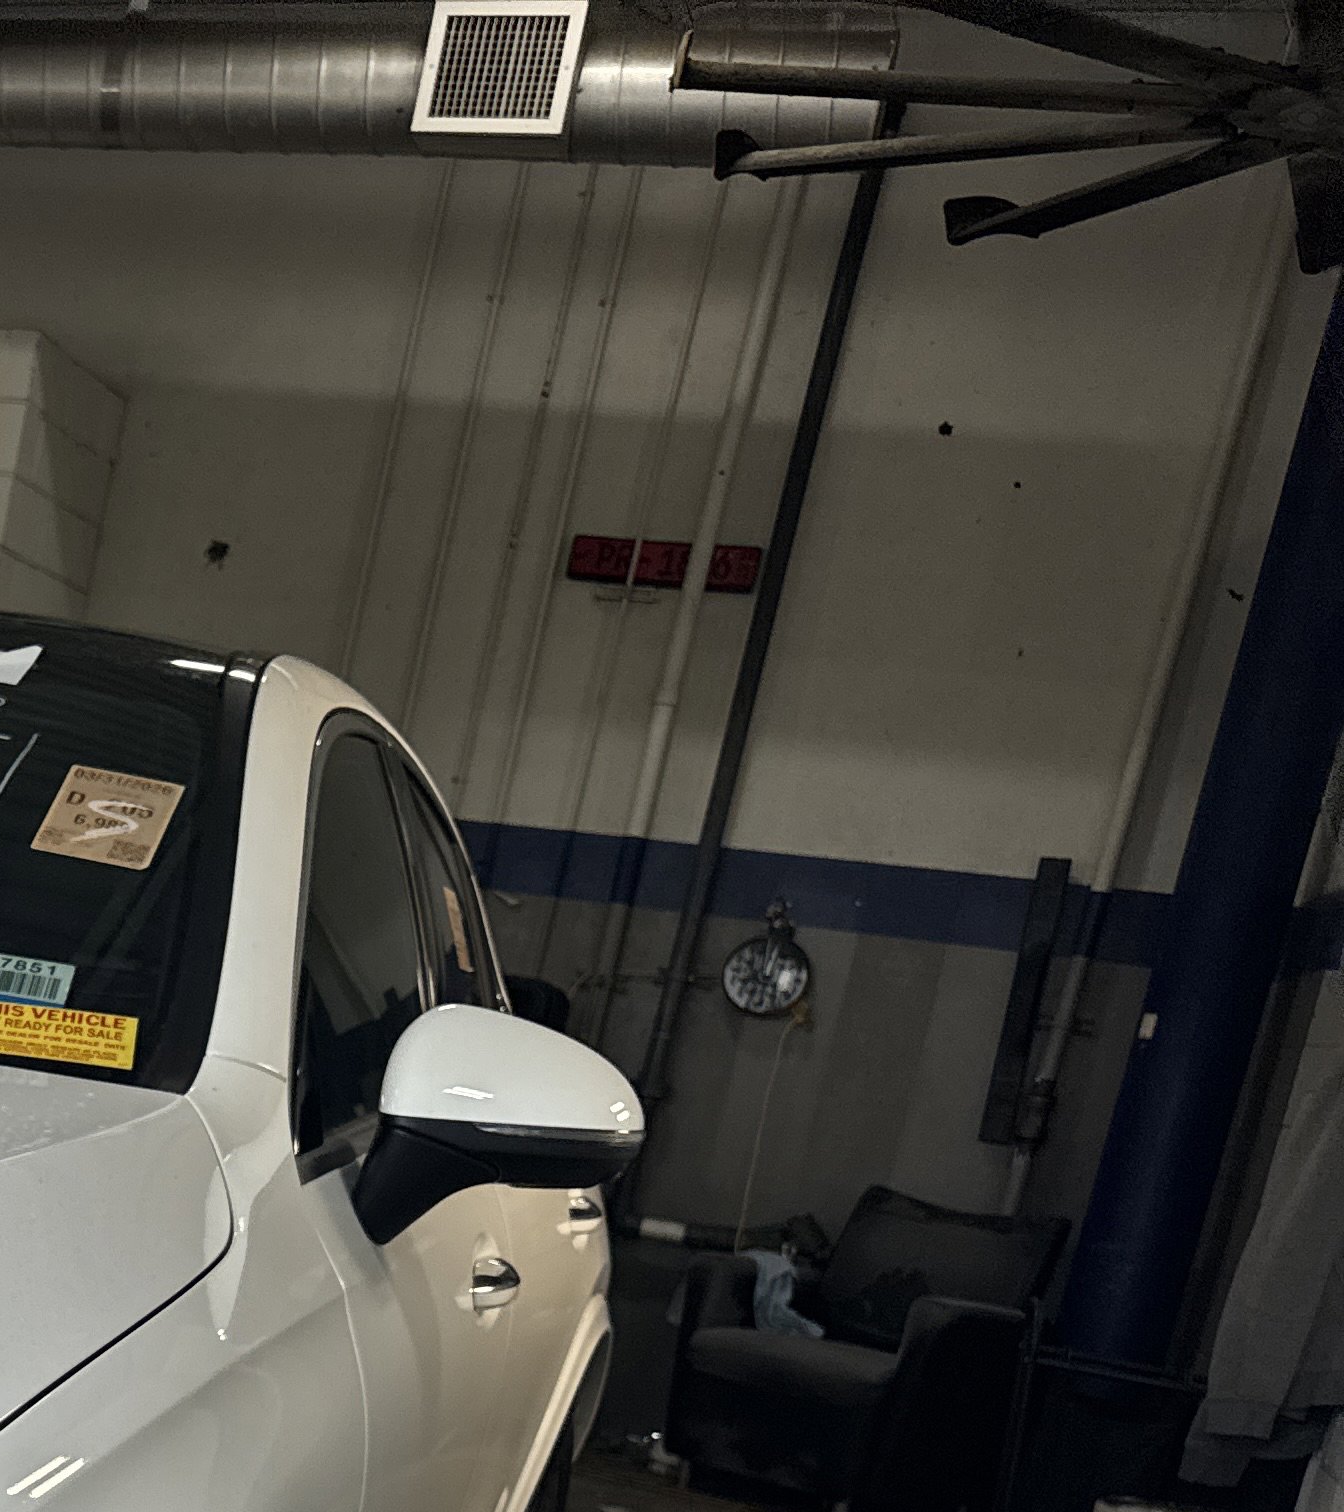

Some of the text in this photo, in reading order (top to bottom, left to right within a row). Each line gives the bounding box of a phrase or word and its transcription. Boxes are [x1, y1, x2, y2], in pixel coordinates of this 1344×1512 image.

[66, 791, 86, 805] D
[4, 1018, 52, 1032] READY
[55, 1023, 84, 1036] FOR
[87, 1028, 123, 1042] SALE
[31, 1007, 127, 1030] VEHICLE
